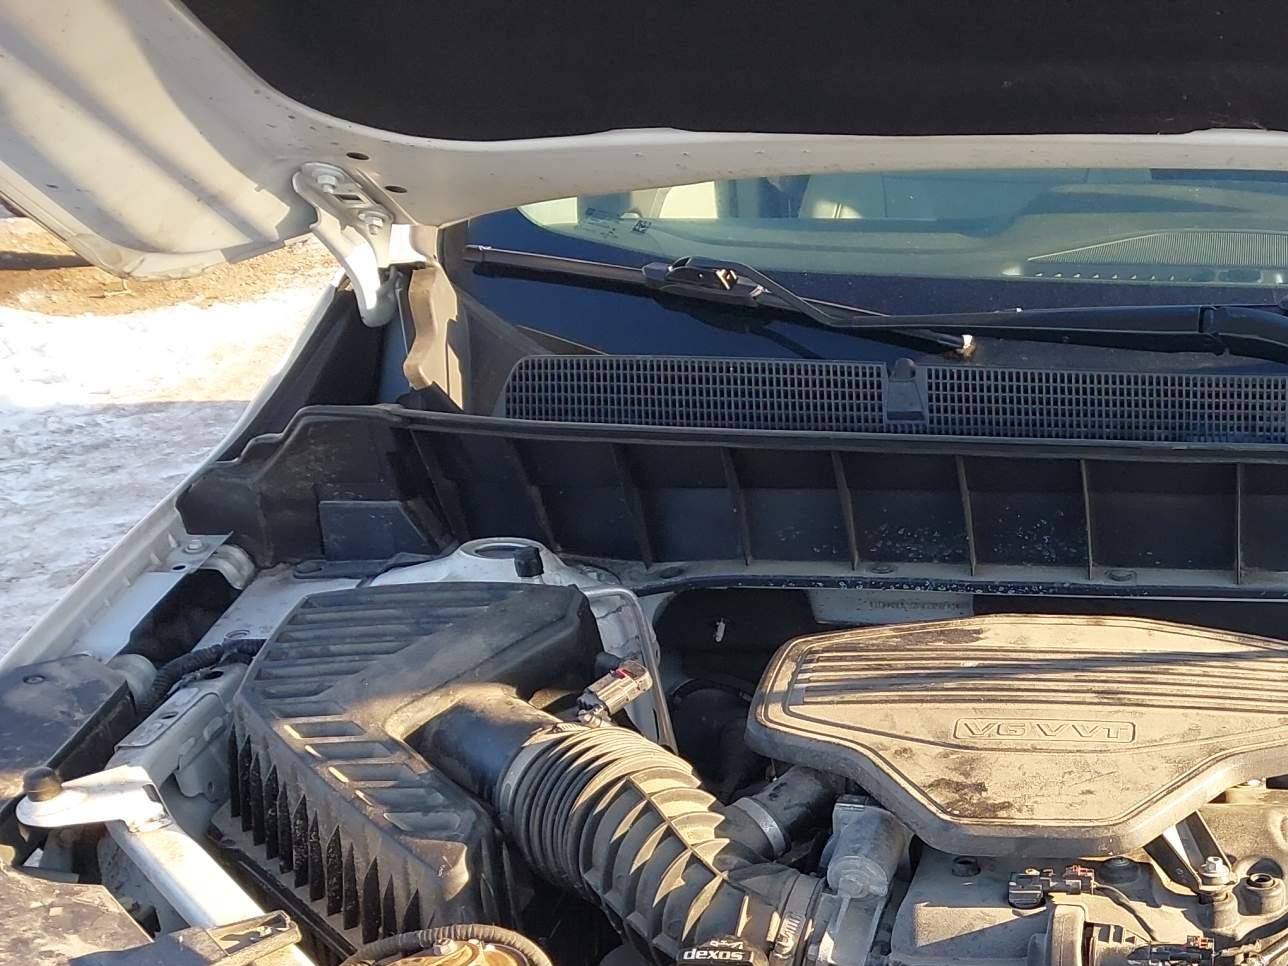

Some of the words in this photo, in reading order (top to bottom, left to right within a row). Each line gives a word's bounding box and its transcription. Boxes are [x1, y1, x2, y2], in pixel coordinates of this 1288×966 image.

[963, 722, 1026, 736] V6
[1036, 723, 1130, 739] VVT
[683, 948, 745, 961] dexos
